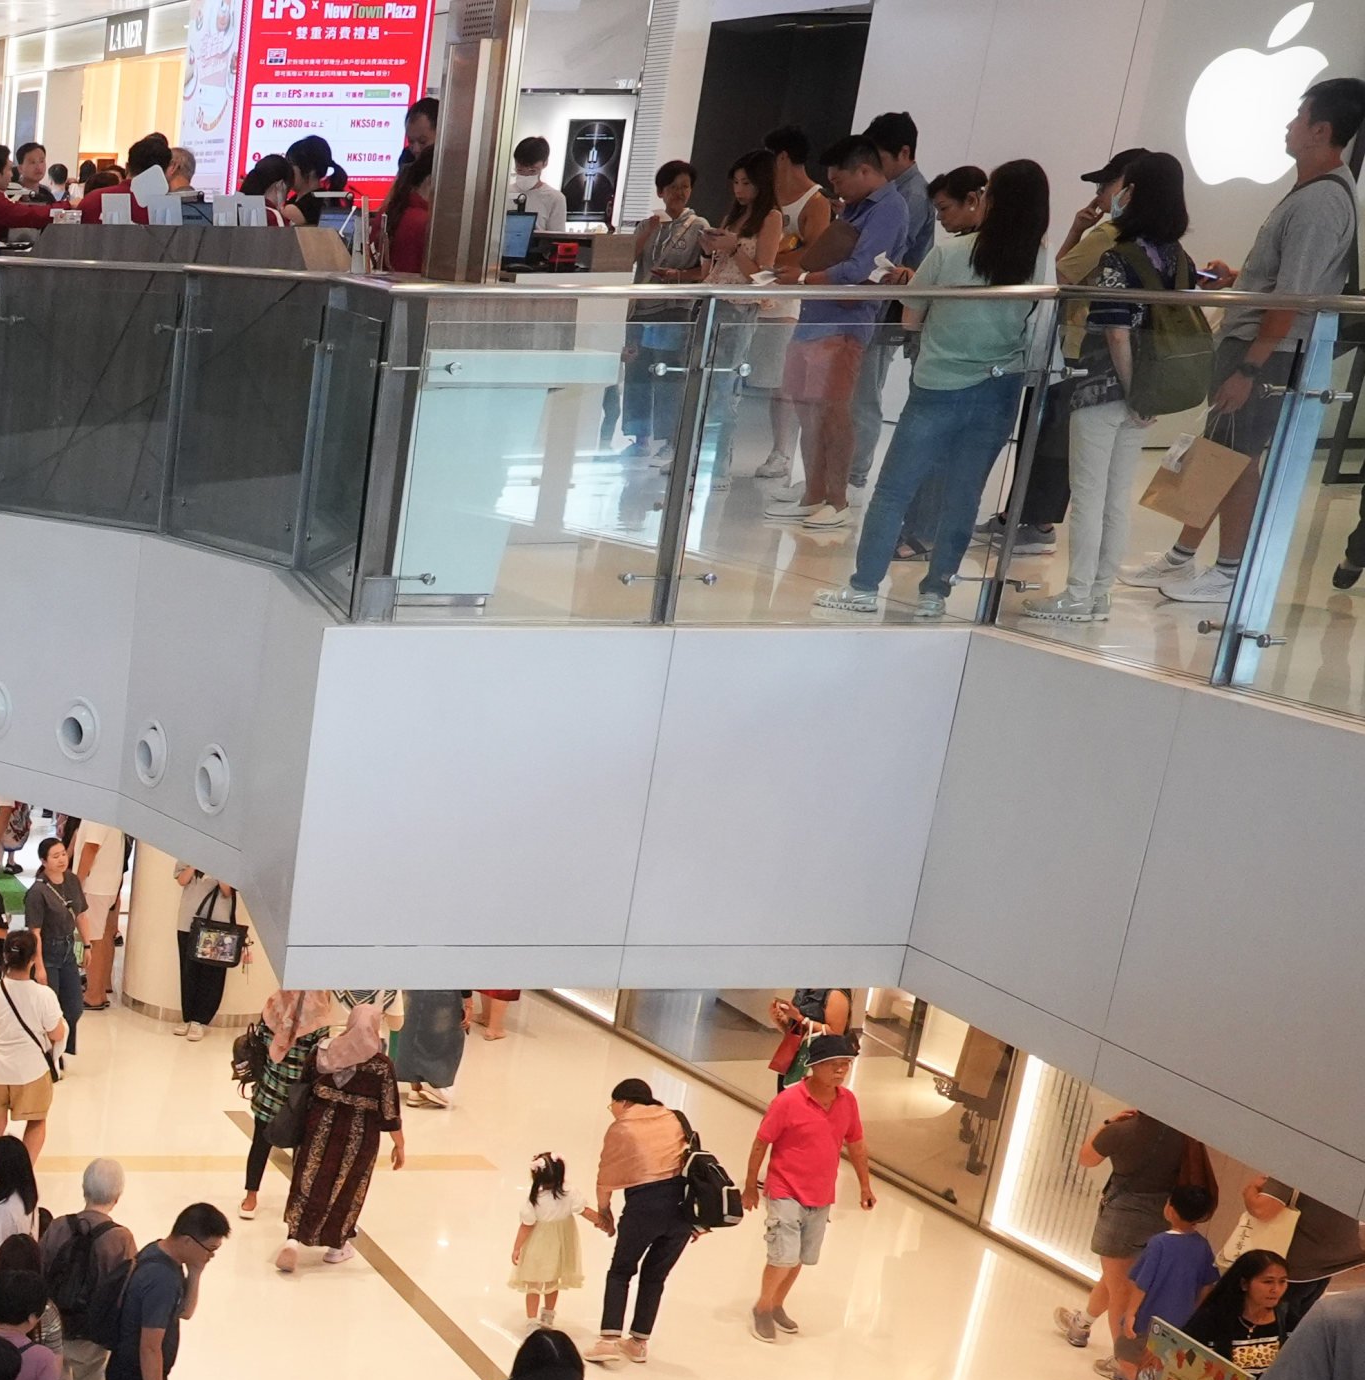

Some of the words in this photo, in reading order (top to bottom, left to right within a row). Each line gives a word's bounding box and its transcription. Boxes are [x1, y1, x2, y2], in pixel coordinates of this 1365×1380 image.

[262, 0, 306, 20] EPS
[324, 3, 352, 19] New
[352, 4, 384, 19] Town
[384, 3, 417, 19] Plaza
[123, 20, 143, 49] MER
